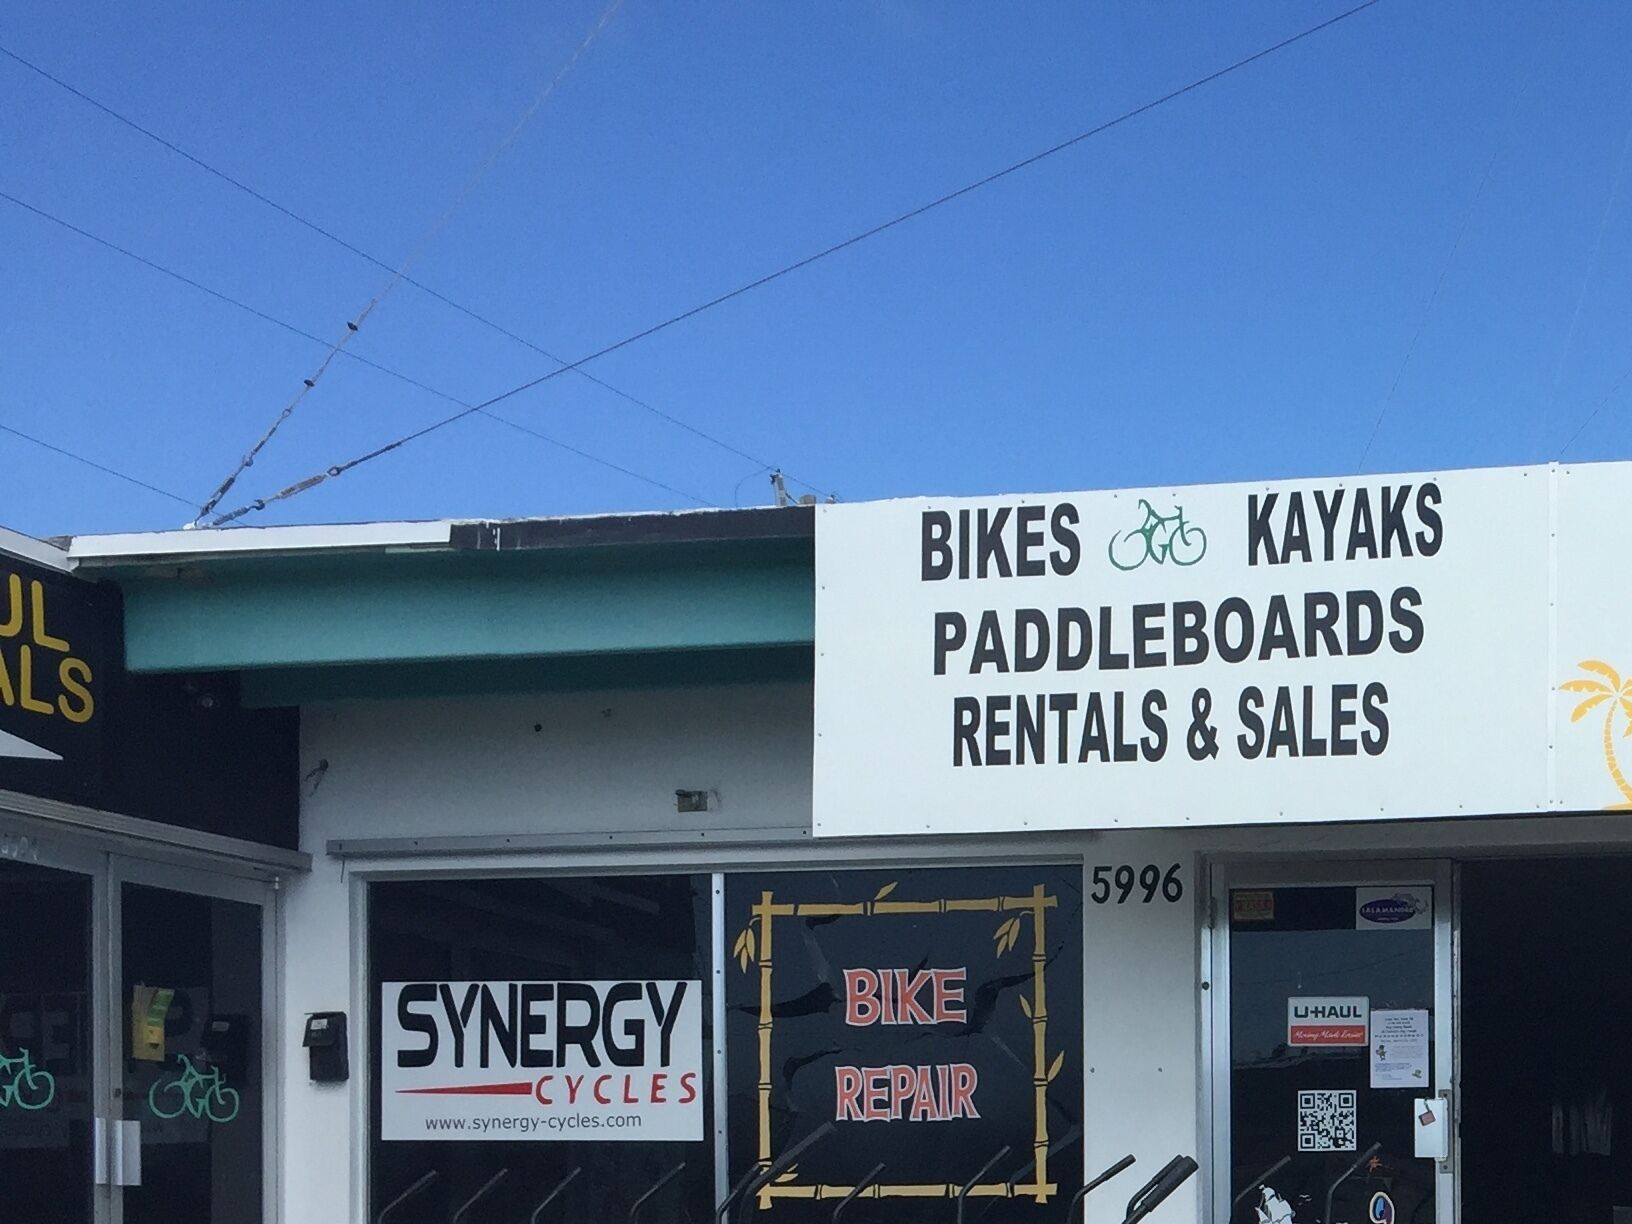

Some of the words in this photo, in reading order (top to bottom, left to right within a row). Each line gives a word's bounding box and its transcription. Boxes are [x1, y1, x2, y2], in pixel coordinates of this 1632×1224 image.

[921, 502, 1081, 581] BIKES
[1249, 482, 1443, 566] KAYAKS
[934, 586, 1424, 675] PADDLEBOARDS
[953, 689, 1168, 766] RENTALS
[1187, 688, 1217, 761] &
[1237, 681, 1389, 759] SALES
[1091, 863, 1183, 904] 5996
[397, 982, 687, 1068] SYNERGY
[843, 967, 967, 1026] BIKE
[1294, 1006, 1362, 1018] U-HAUL
[535, 1072, 696, 1104] CYCLES
[835, 1063, 981, 1122] REPAIR
[425, 1113, 641, 1132] www.synergy-cycles.com
